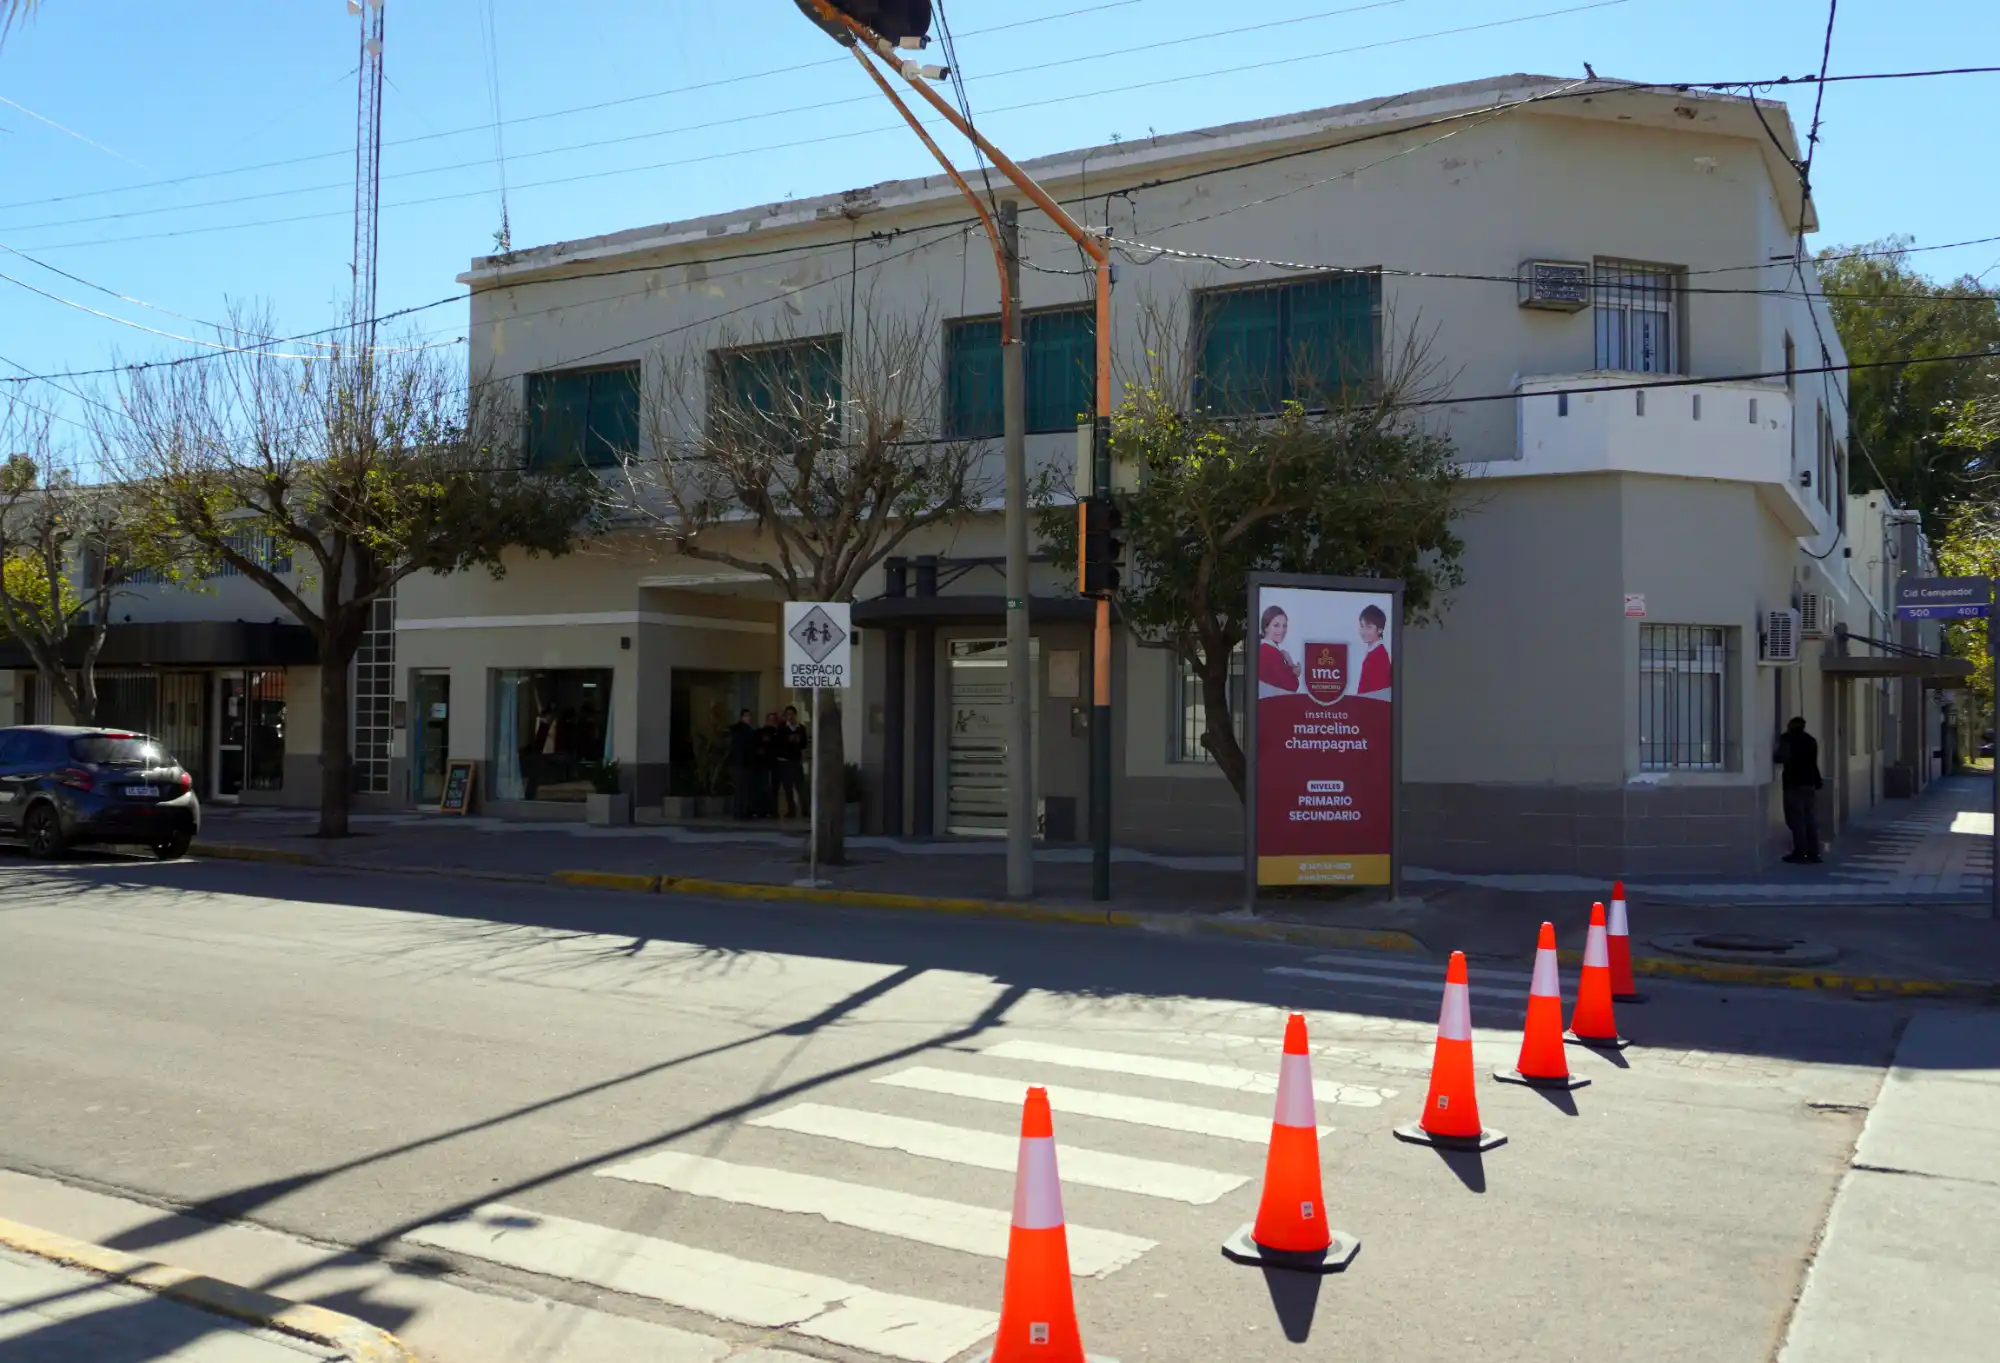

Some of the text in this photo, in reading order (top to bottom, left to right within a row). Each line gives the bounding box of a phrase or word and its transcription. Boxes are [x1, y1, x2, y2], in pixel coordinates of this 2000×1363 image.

[1903, 588, 1973, 598] Cid Campeador
[1909, 607, 1979, 617] 500 400
[791, 664, 843, 675] DESPACIO
[792, 676, 842, 687] ESCUELA
[1305, 710, 1349, 720] instituto
[1293, 722, 1360, 735] marcelino
[1285, 737, 1368, 753] champagnat
[1298, 795, 1353, 806] PRIMARIO
[1289, 810, 1362, 821] SECUNDARIO
